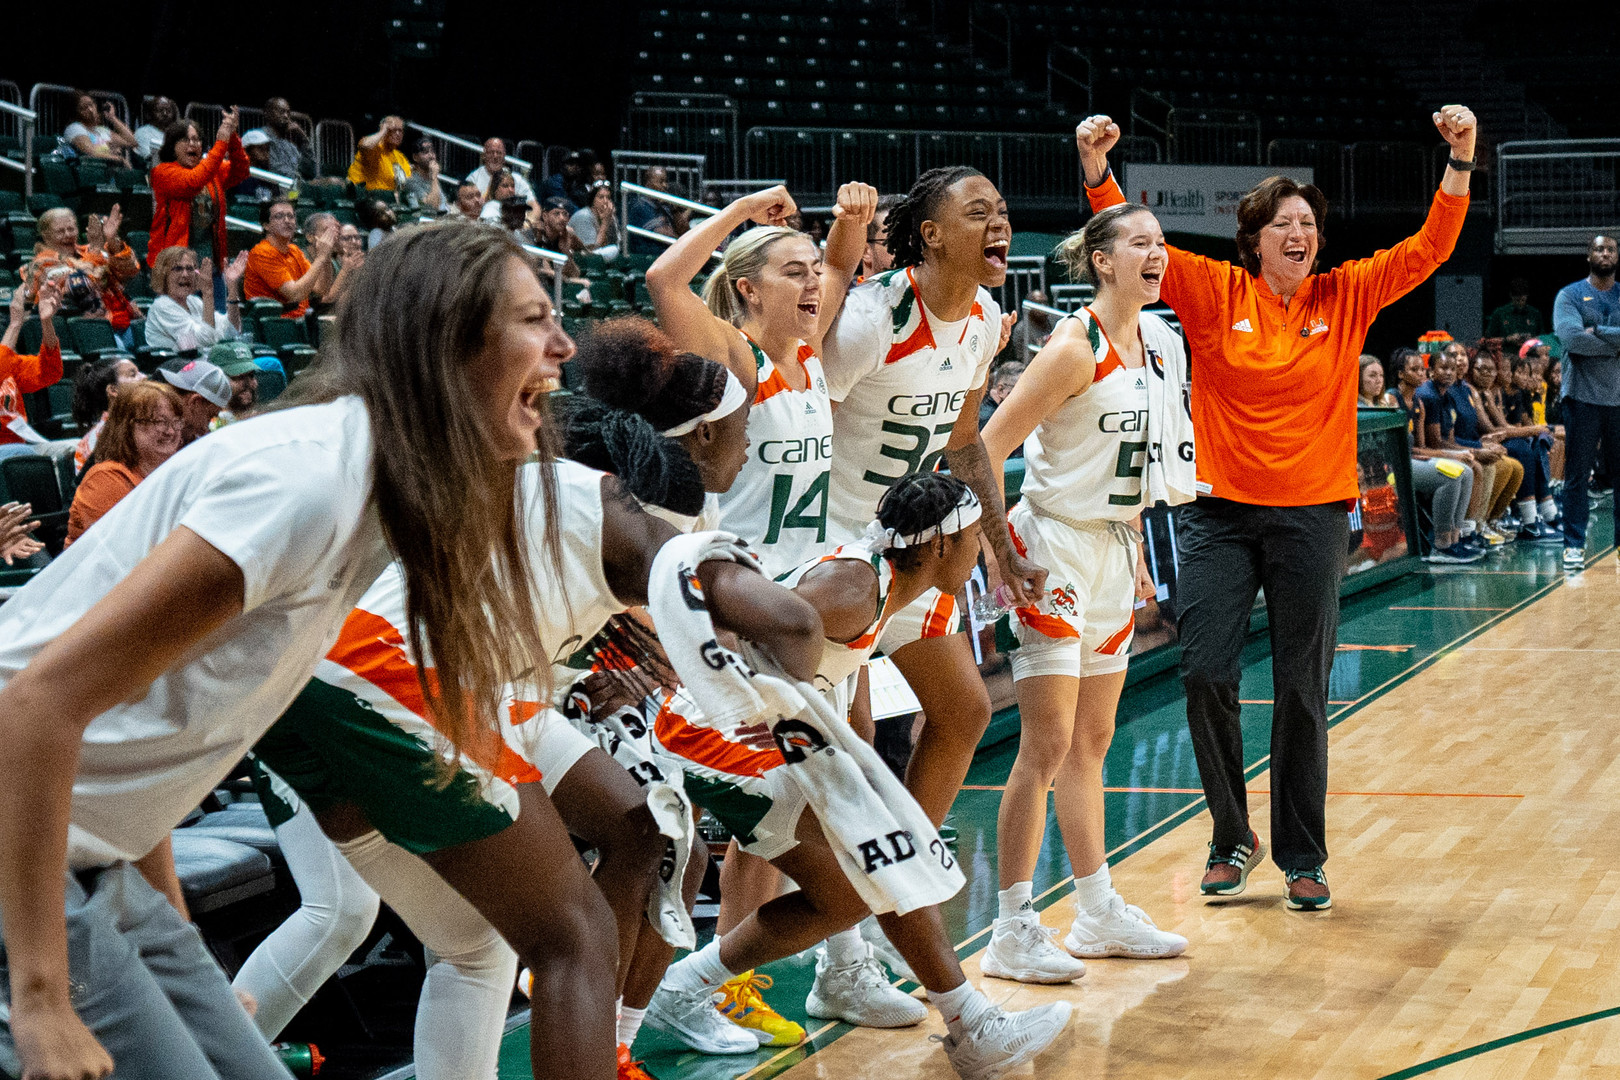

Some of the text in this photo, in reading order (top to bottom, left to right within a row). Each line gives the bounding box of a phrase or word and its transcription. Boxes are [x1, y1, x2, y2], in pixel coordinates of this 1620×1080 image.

[1098, 410, 1149, 433] can
[758, 435, 833, 464] cane
[1108, 441, 1148, 506] 5
[762, 470, 831, 544] 14
